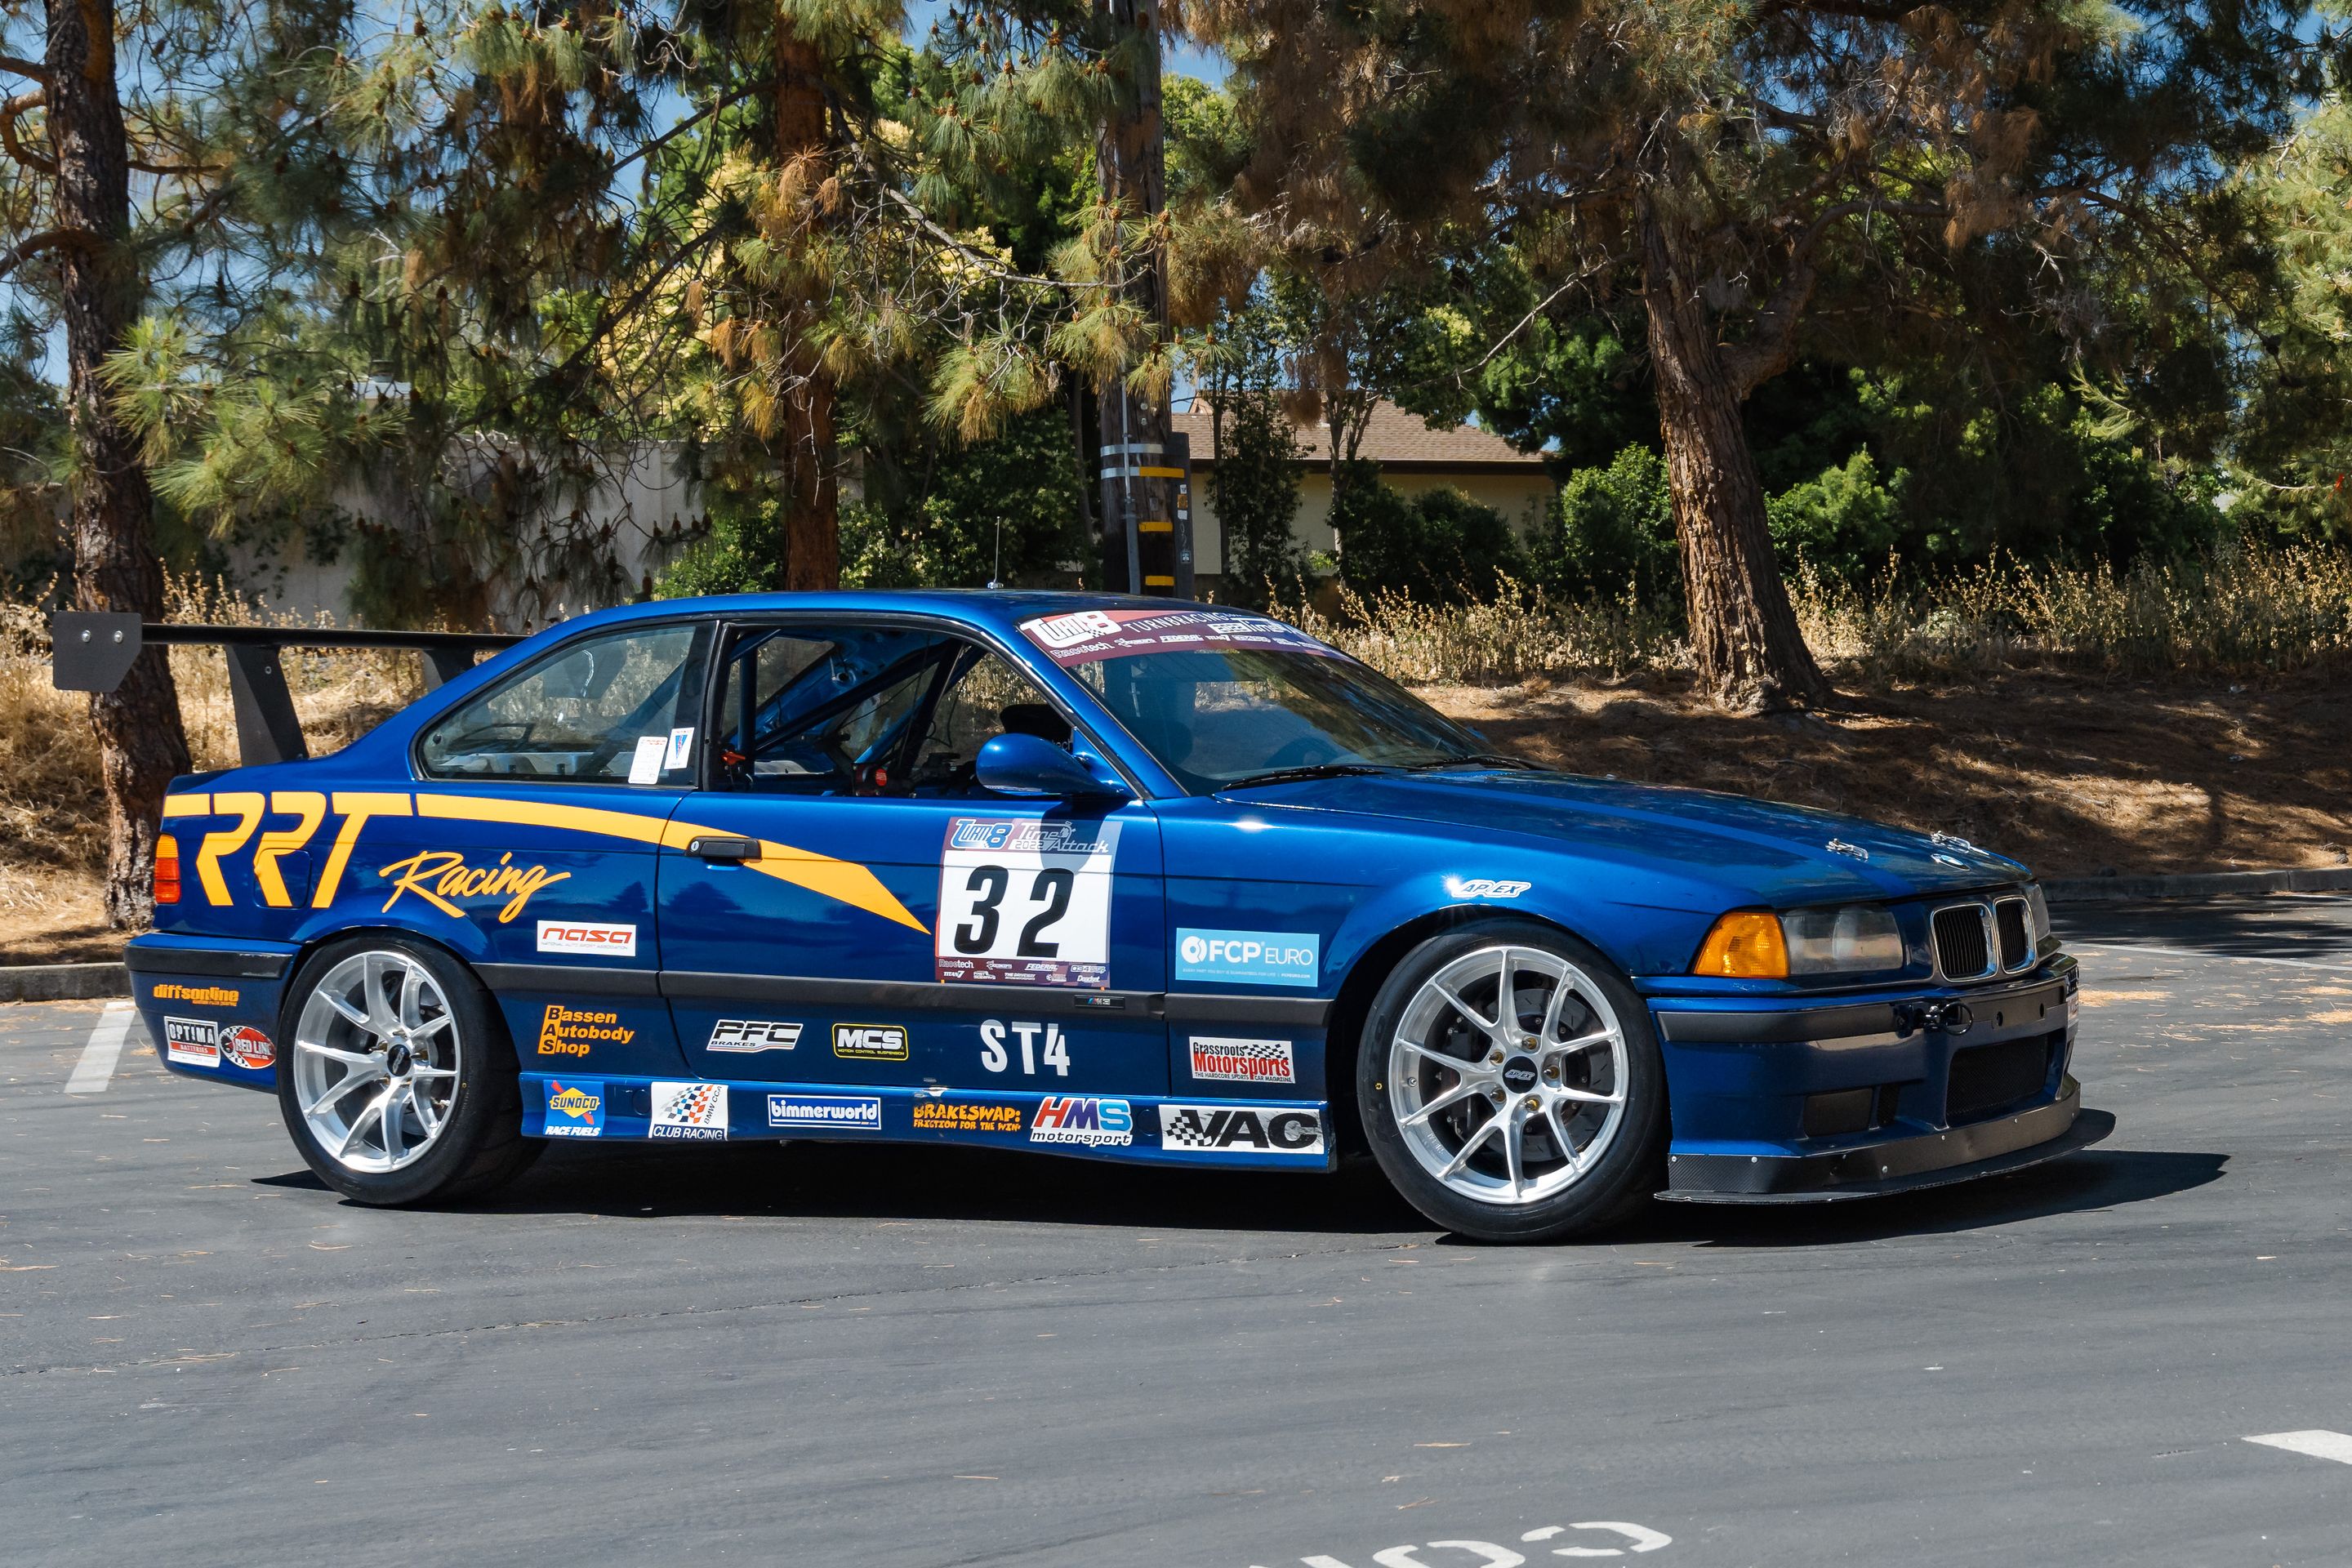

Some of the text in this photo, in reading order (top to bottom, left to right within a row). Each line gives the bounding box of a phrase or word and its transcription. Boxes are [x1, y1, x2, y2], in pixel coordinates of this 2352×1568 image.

[1019, 822, 1061, 840] Time
[196, 791, 412, 908] RRT
[1015, 839, 1109, 853] 2022 Attack
[379, 852, 571, 923] Racing
[1458, 883, 1522, 895] APEX
[954, 865, 1074, 958] 32
[1209, 940, 1313, 966] FCP EURO
[1024, 963, 1059, 971] FEDERAL
[153, 984, 239, 1002] diffsonline
[547, 1007, 617, 1024] Bassen
[543, 1023, 635, 1045] Autobody
[712, 1021, 802, 1043] PFC
[837, 1028, 903, 1049] MCS
[180, 1044, 208, 1054] BATTERIES
[234, 1038, 252, 1052] RED
[541, 1039, 590, 1057] Shop
[980, 1019, 1071, 1076] ST4
[1192, 1041, 1245, 1056] Grassroots
[1193, 1052, 1290, 1080] Motorsports
[1505, 1069, 1535, 1080] APEX
[552, 1096, 597, 1109] SUNOCO
[771, 1100, 877, 1120] bimmerworld
[1033, 1097, 1132, 1131] HMS
[545, 1125, 601, 1137] RACE FUELS
[653, 1125, 724, 1140] CLUB RACING
[960, 1120, 977, 1129] FOR
[980, 1121, 996, 1130] THE
[1173, 1109, 1317, 1149] VAC
[1032, 1131, 1131, 1145] motorsport
